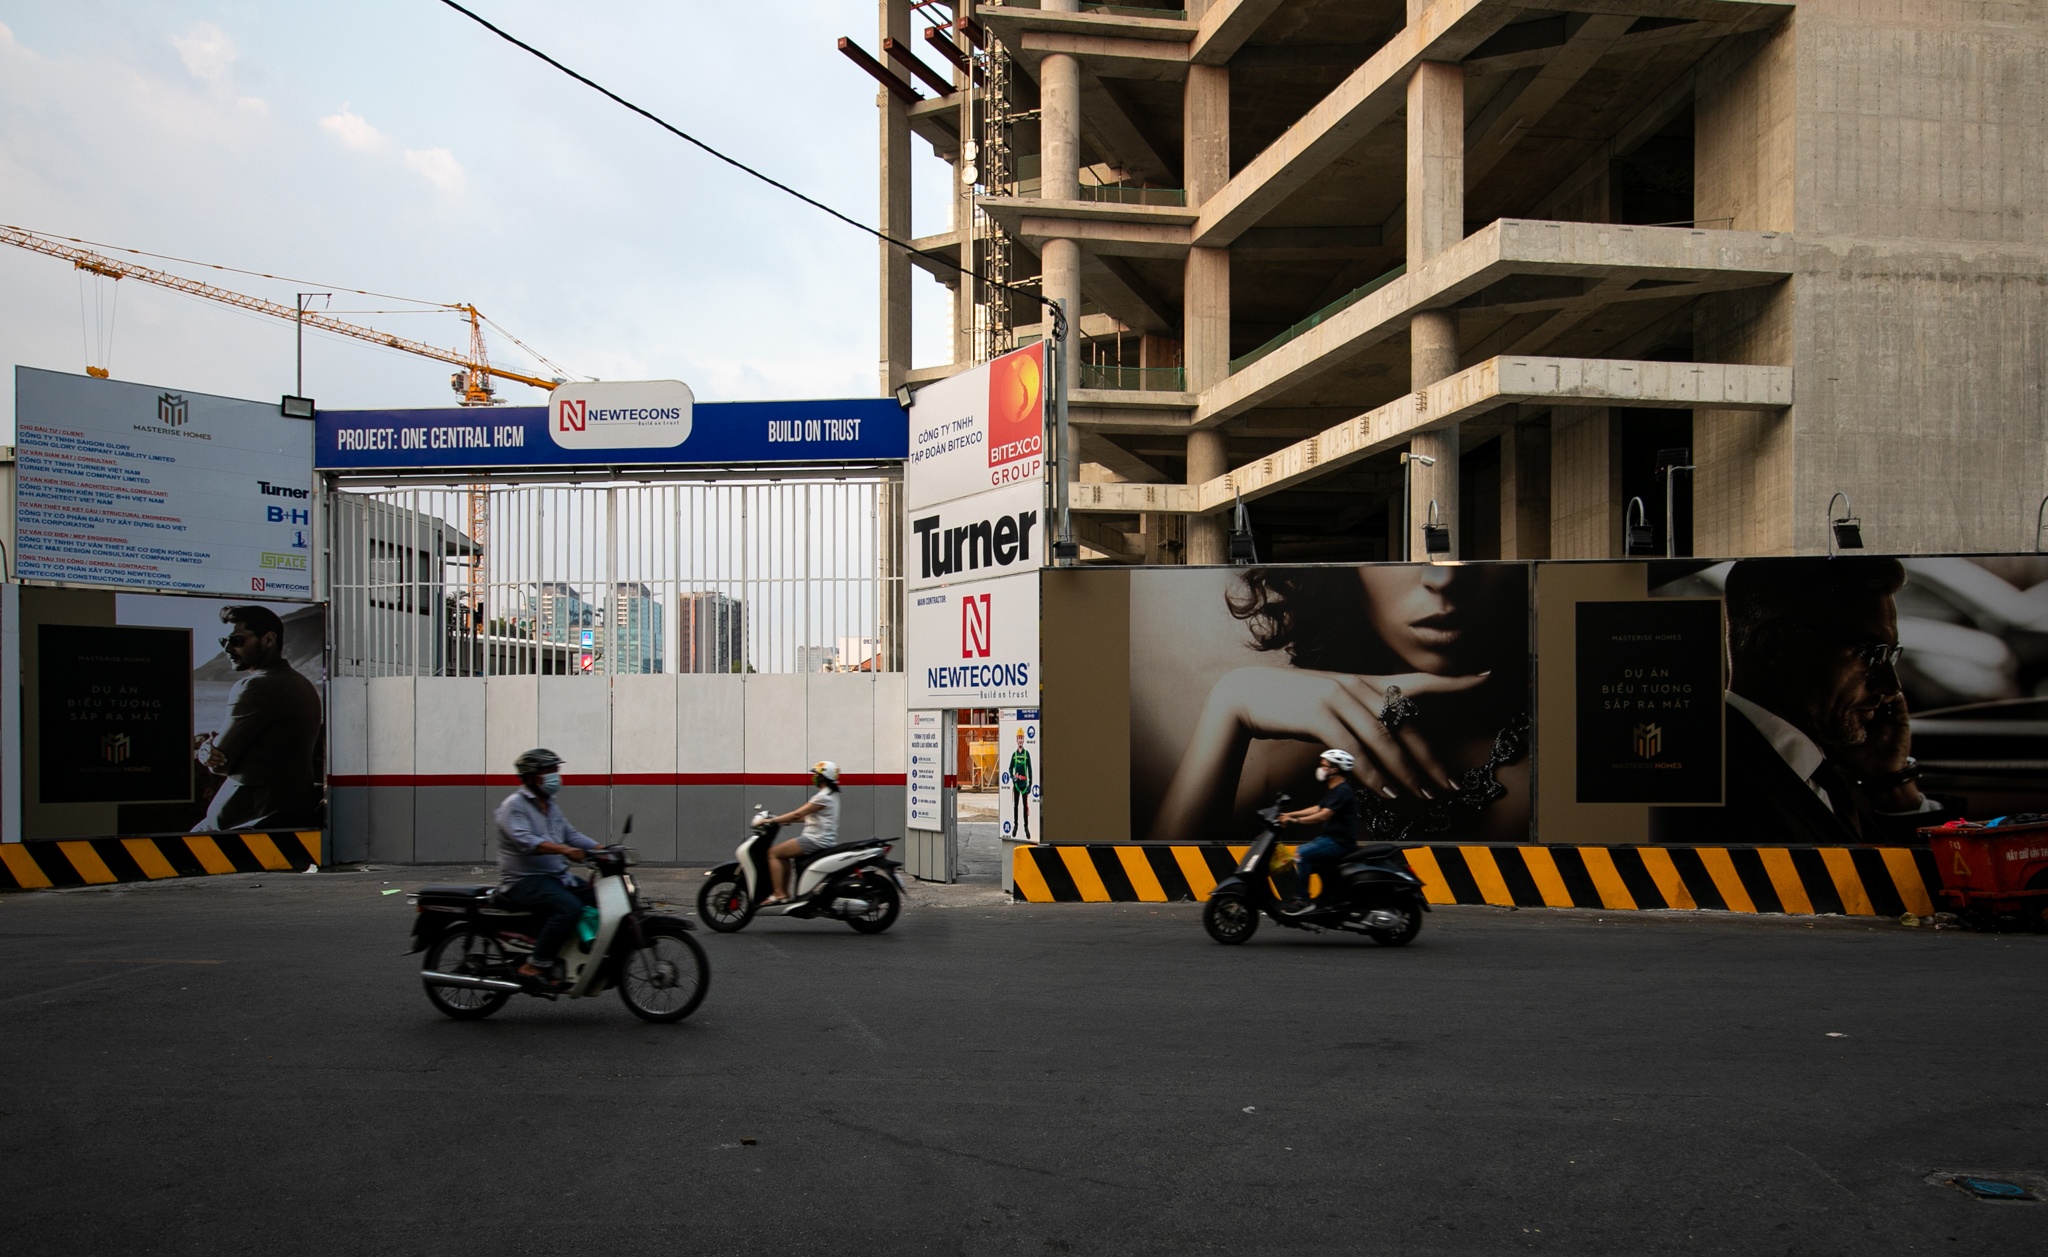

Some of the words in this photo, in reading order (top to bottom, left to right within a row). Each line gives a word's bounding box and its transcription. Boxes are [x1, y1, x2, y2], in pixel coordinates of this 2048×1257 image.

[589, 408, 680, 421] NEWTECONS
[134, 425, 181, 436] MASTERISE
[183, 431, 212, 440] HOMES
[338, 428, 398, 450] PROJECT:
[401, 428, 427, 449] ONE
[431, 427, 490, 449] CENTRAL
[494, 426, 524, 447] HCM
[768, 420, 802, 442] BUILD
[805, 420, 820, 442] ON
[824, 419, 861, 441] TRUST
[918, 428, 939, 445] CÔNG
[941, 423, 952, 437] TY
[952, 415, 974, 433] TNHH
[20, 432, 42, 440] CÔNG
[55, 436, 75, 444] TNHH
[77, 438, 104, 447] SAIGON
[106, 442, 131, 450] GLORY
[911, 450, 924, 465] TẬP
[926, 442, 947, 459] ĐOÀN
[948, 431, 983, 452] BITEXCO
[991, 435, 1040, 463] BITEXCO
[20, 439, 49, 447] SAIGON
[51, 441, 76, 450] GLORY
[78, 444, 113, 455] COMPANY
[114, 450, 147, 459] LIABILITY
[149, 455, 176, 463] LIMITED
[20, 464, 50, 472] TURNER
[52, 467, 84, 476] VIETNAM
[86, 471, 121, 481] COMPANY
[77, 463, 106, 471] TURNER
[992, 460, 1040, 486] GROUP
[36, 492, 77, 502] ARCHITECT
[257, 481, 309, 499] Turner
[267, 506, 308, 525] B+H
[42, 519, 95, 529] CORPORATION
[914, 510, 1037, 579] Turner
[64, 547, 91, 555] DESIGN
[93, 550, 139, 559] CONSULTANT
[141, 554, 174, 562] COMPANY
[18, 570, 66, 578] NEWTECONS
[68, 574, 124, 583] CONSTRUCTION
[128, 571, 171, 579] NEWTECONS
[266, 583, 310, 591] NEWTECONS
[917, 598, 926, 606] MAIN
[928, 663, 1028, 689] NEWTECONS
[1625, 669, 1643, 680] DỰ
[1651, 667, 1669, 677] ÁN
[980, 690, 996, 699] Build
[1009, 690, 1028, 699] trust
[1638, 701, 1655, 709] RA
